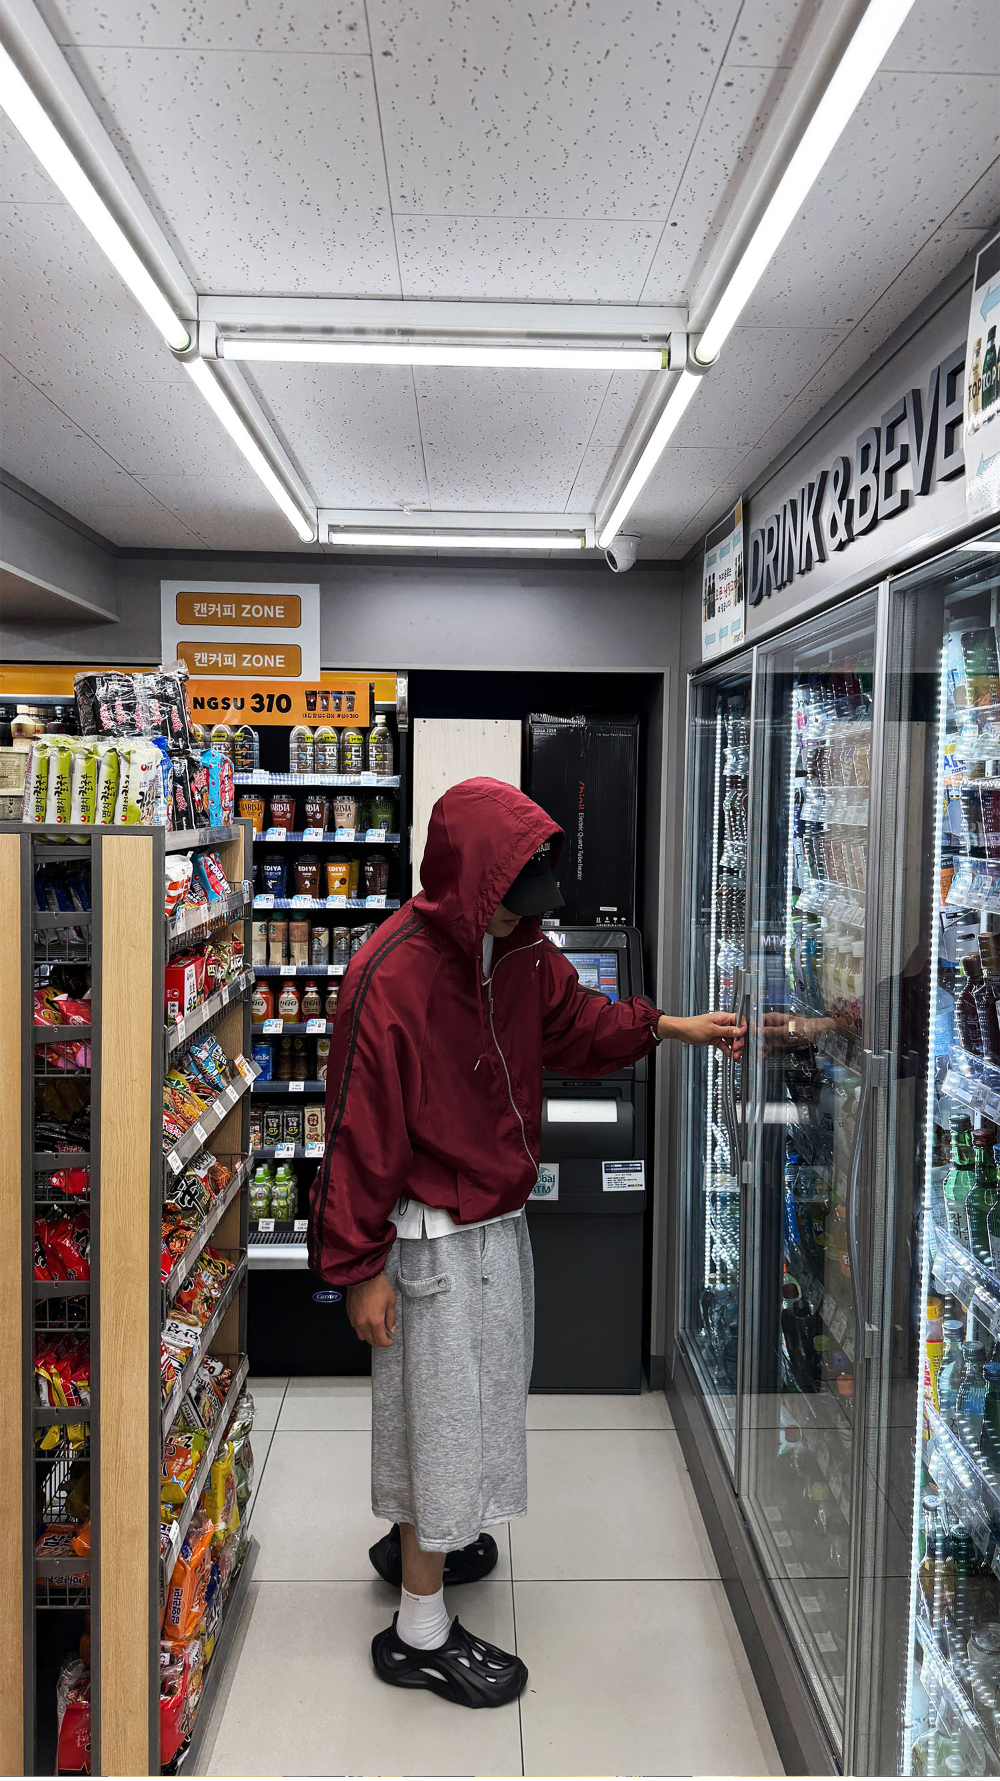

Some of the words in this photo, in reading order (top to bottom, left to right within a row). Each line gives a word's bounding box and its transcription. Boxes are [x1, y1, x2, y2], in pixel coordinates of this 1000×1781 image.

[193, 603, 236, 618] 캔커피
[241, 604, 285, 618] ZONE
[194, 652, 236, 668] 캔커피
[241, 654, 285, 668] ZONE
[193, 696, 244, 710] NGSU
[250, 693, 292, 714] 310
[171, 1587, 183, 1625] 삼양라면
